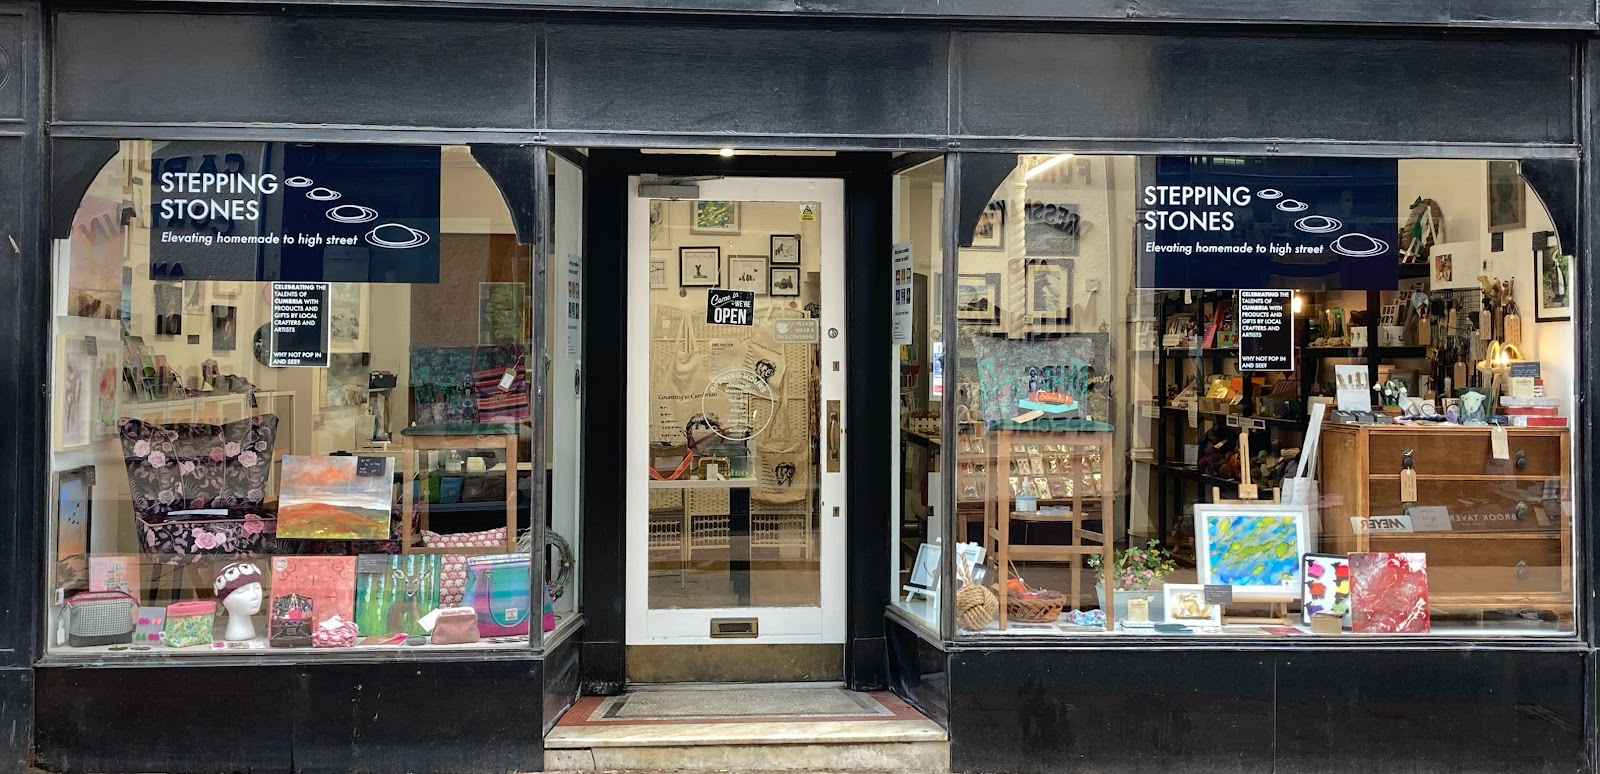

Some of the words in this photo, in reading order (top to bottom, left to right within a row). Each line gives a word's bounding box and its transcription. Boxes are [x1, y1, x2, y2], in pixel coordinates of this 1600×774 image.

[160, 171, 278, 196] STEPPING
[1143, 185, 1251, 207] STEPPING
[160, 198, 260, 222] STONES
[1143, 210, 1234, 232] STONES
[161, 231, 213, 247] Elevating
[216, 231, 280, 246] homemade
[283, 232, 293, 246] to
[297, 231, 323, 248] high
[326, 233, 358, 247] street
[1145, 241, 1192, 256] Elevating
[1195, 241, 1253, 254] homemade
[1256, 243, 1267, 254] to
[1269, 242, 1291, 257] high
[1295, 243, 1324, 255] street
[711, 294, 731, 306] Come
[735, 300, 751, 308] WE'RE
[715, 307, 747, 325] OPEN
[710, 372, 742, 392] OPENING
[743, 373, 765, 393] HOURS
[658, 394, 684, 402] Counting
